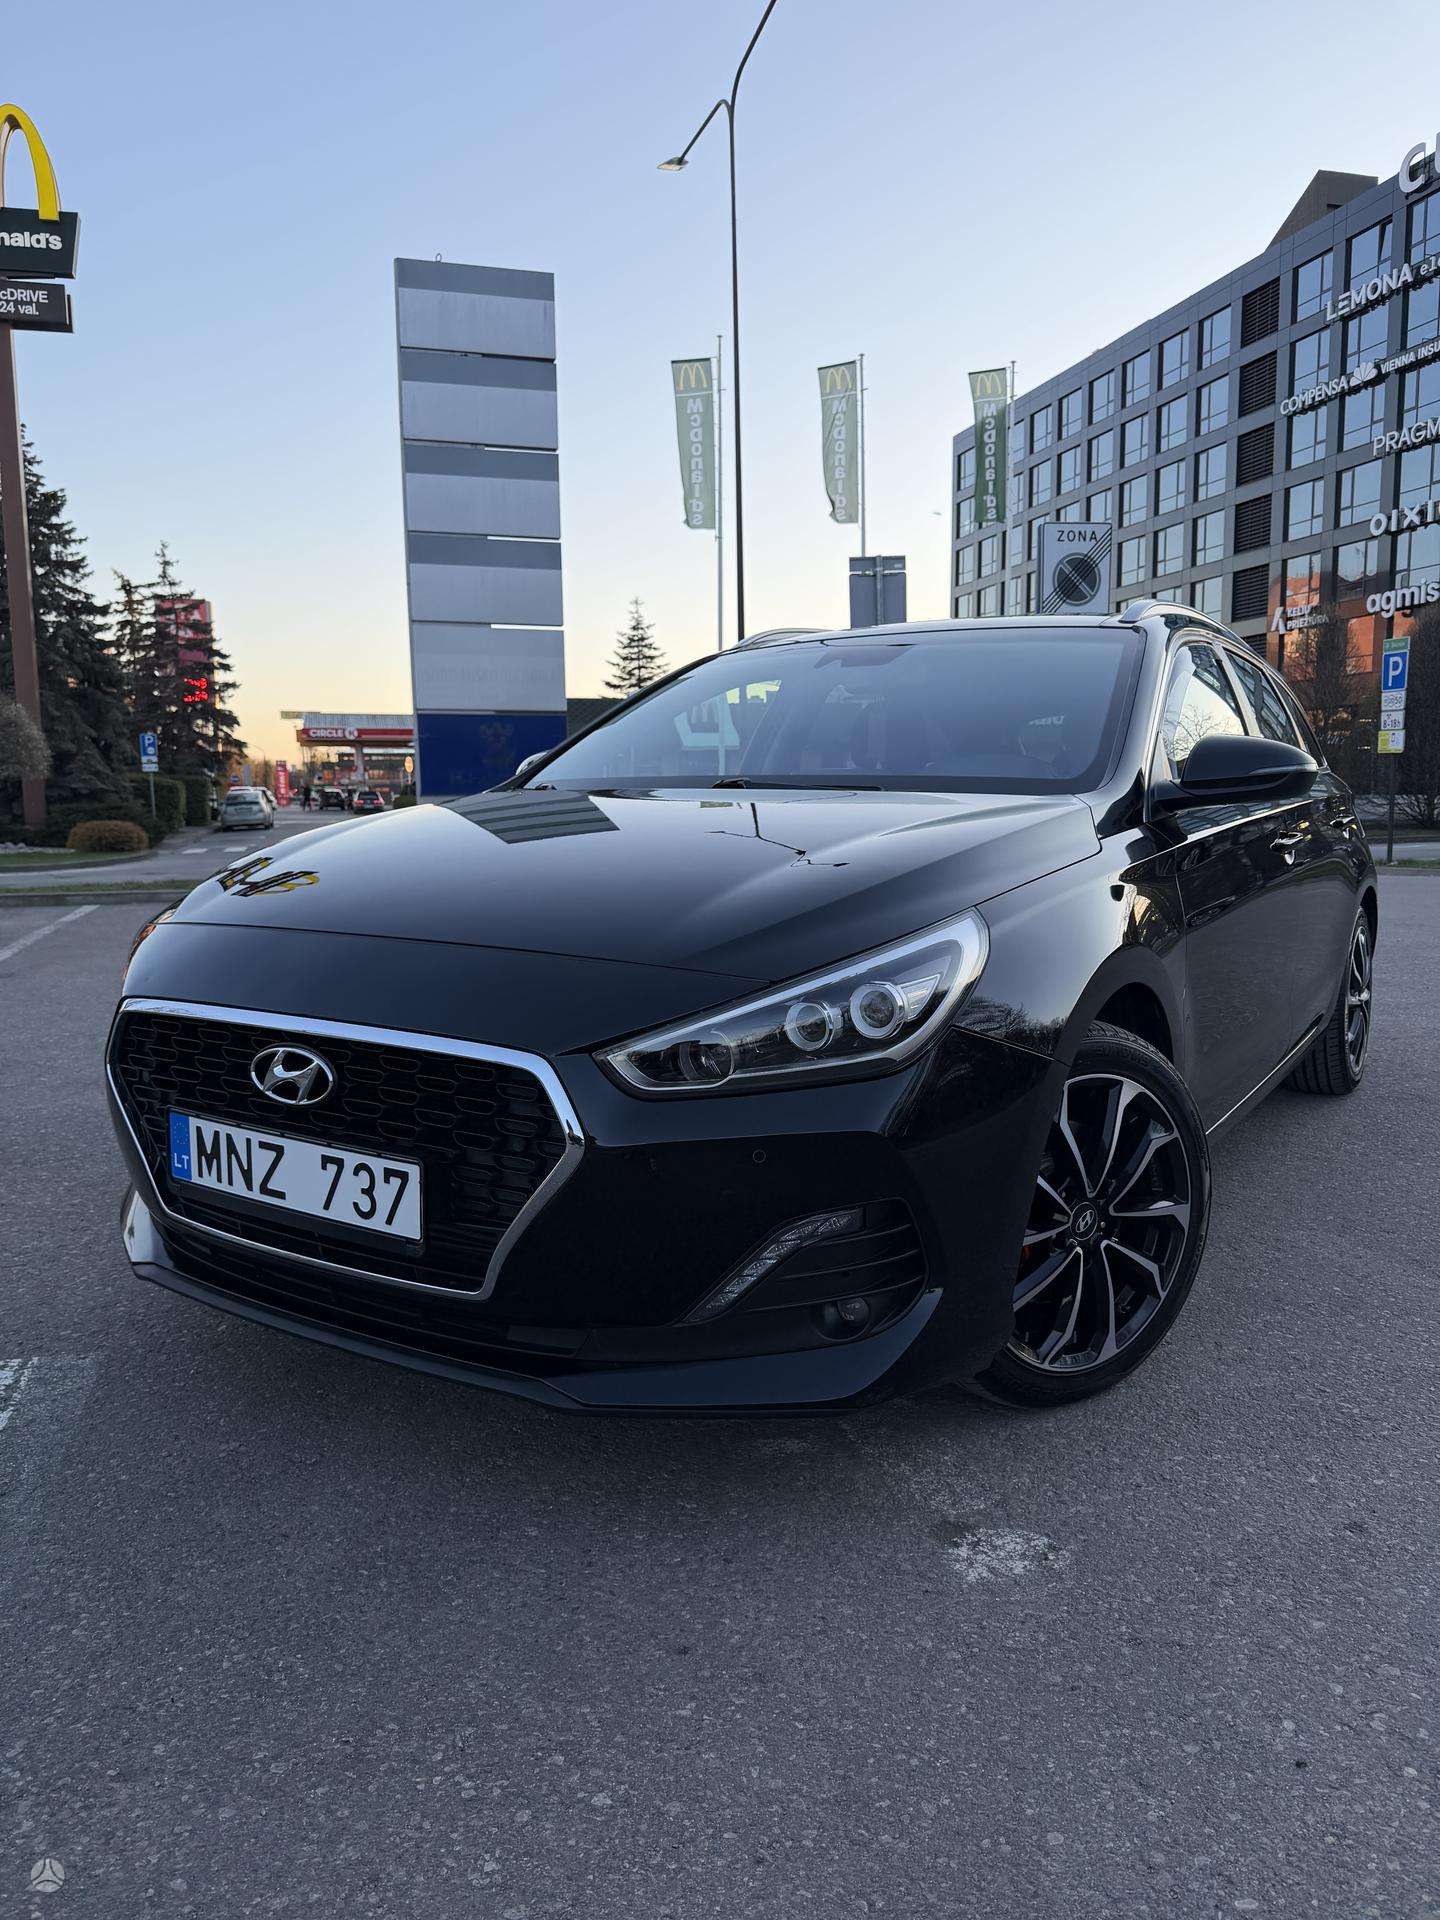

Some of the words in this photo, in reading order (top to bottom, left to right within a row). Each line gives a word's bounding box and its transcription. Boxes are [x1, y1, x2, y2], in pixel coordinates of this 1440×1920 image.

[1399, 131, 1440, 193] C
[0, 302, 15, 313] 24
[1327, 263, 1414, 320] LEMONA
[1280, 375, 1348, 415] COMPENSA
[1380, 351, 1416, 374] VIENNA
[1057, 530, 1098, 542] ZONA
[1366, 577, 1440, 618] agmis
[1388, 656, 1403, 687] P
[310, 728, 344, 738] CIRCLE
[174, 1153, 189, 1169] LT
[195, 1125, 287, 1200] MNZ
[320, 1153, 410, 1226] 737
